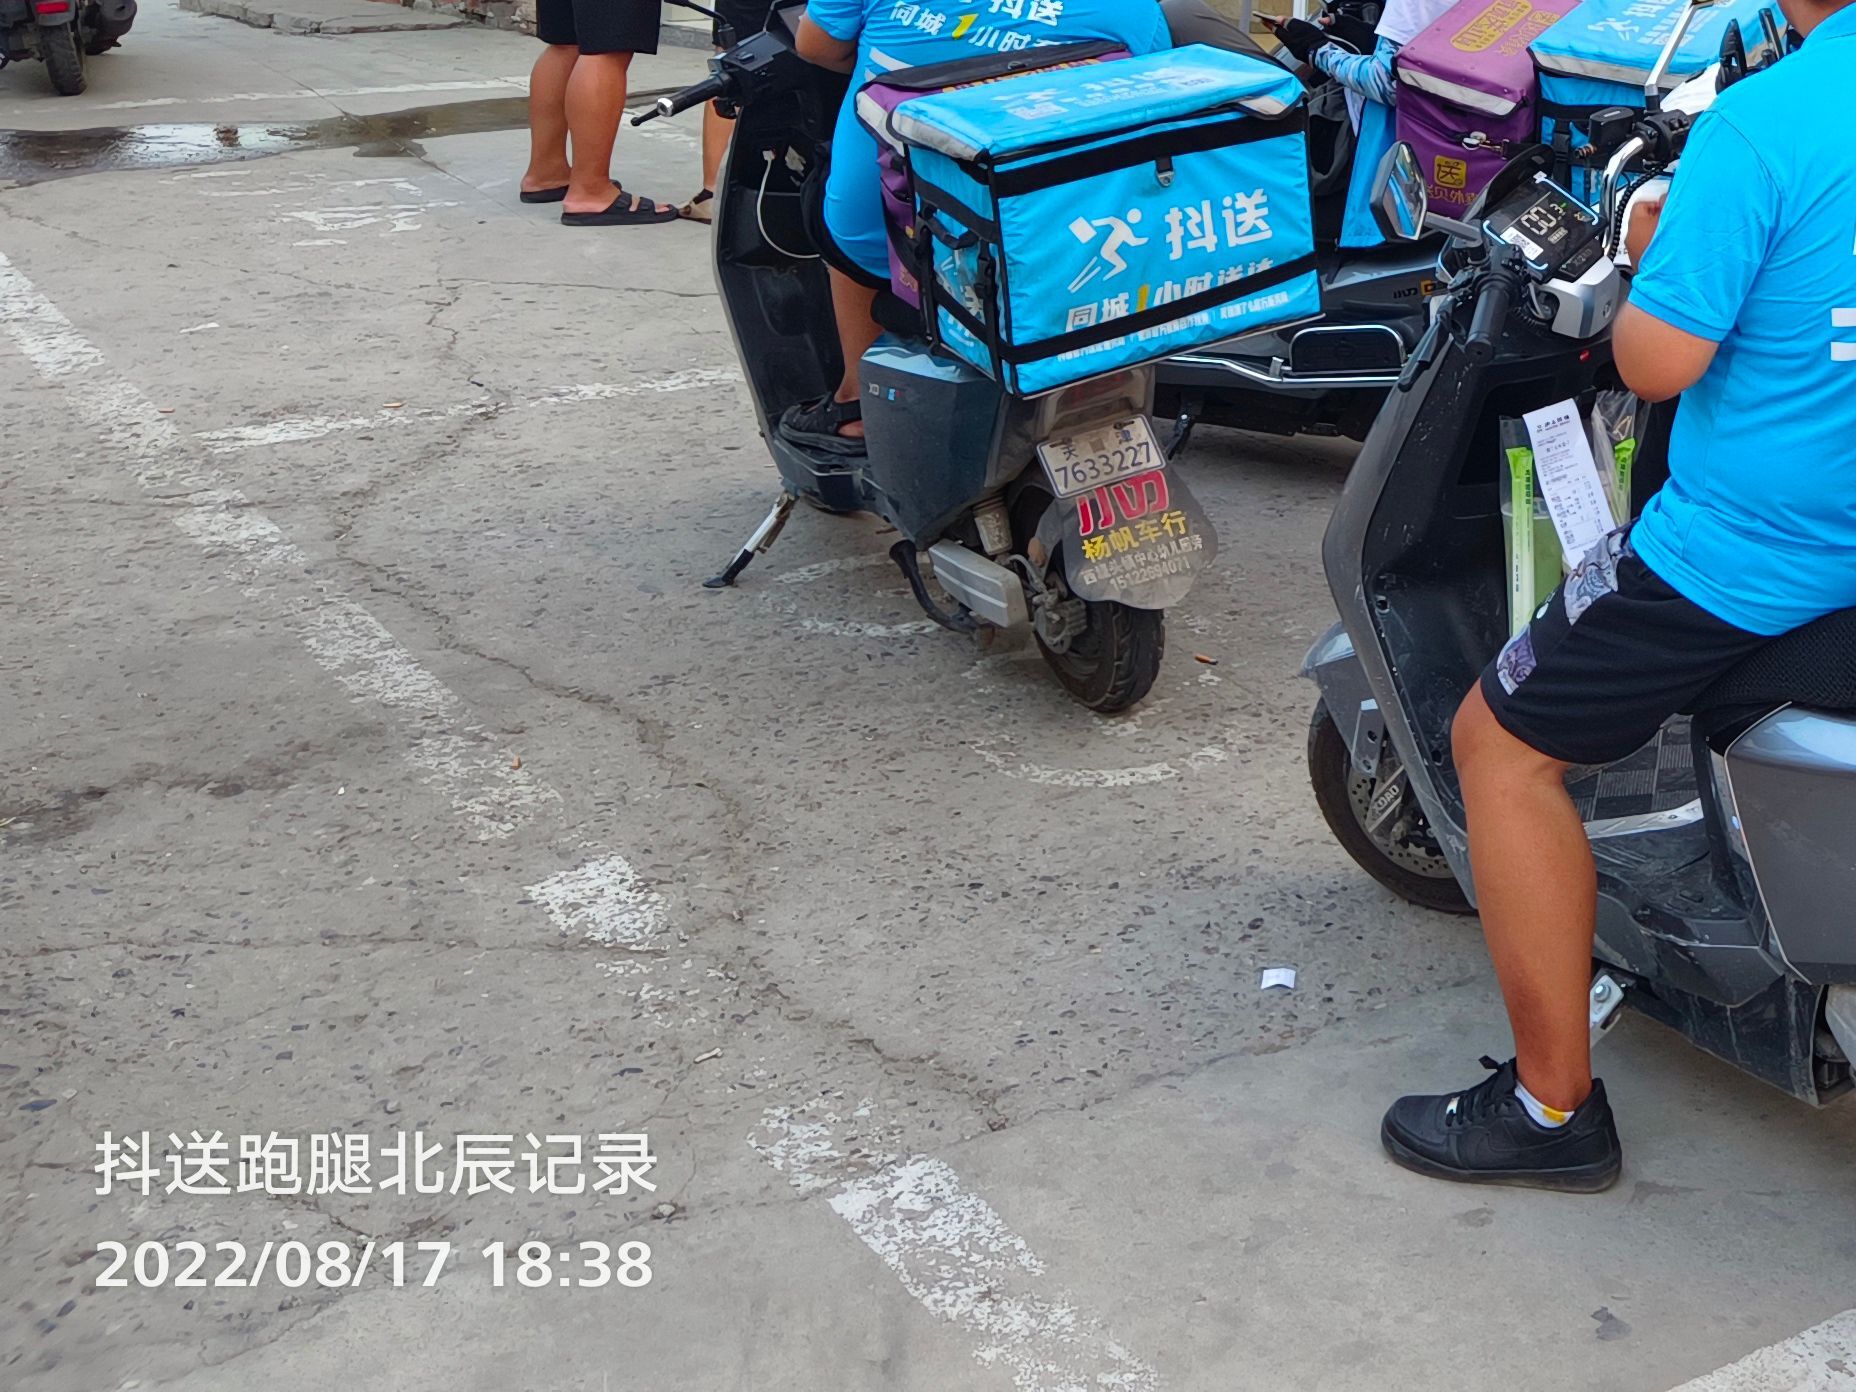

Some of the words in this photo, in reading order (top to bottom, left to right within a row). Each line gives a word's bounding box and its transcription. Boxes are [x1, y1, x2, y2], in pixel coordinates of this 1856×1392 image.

[1164, 187, 1274, 261] 抖送
[1054, 441, 1152, 490] 7633227
[1081, 510, 1187, 563] 杨帆车行
